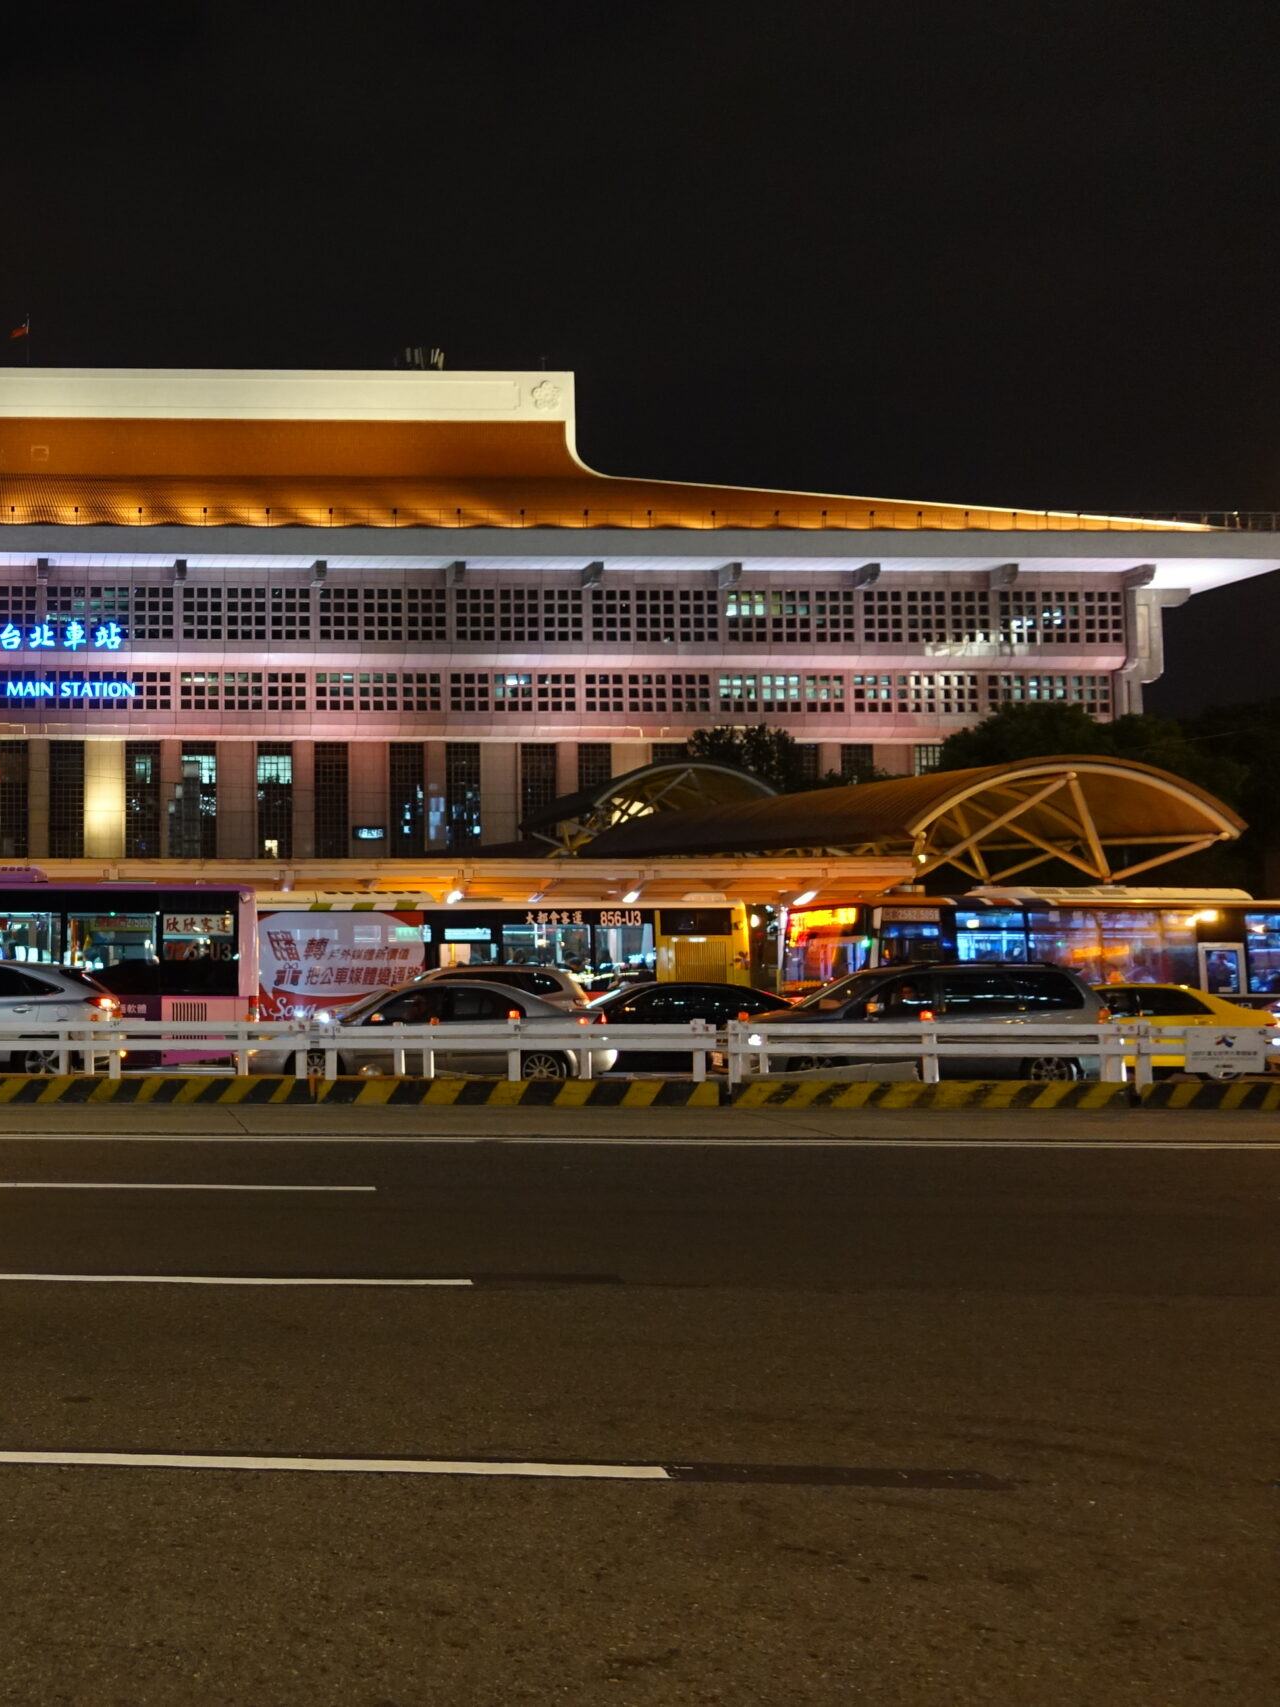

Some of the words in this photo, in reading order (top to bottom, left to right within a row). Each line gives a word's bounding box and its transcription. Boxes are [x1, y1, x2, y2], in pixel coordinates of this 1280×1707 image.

[0, 621, 122, 651] 台北車站
[6, 681, 54, 698] MAIN
[61, 682, 136, 698] STATION
[166, 917, 231, 933] 欣欣客運
[525, 911, 584, 925] 大都會客運
[600, 910, 641, 926] 856-U3
